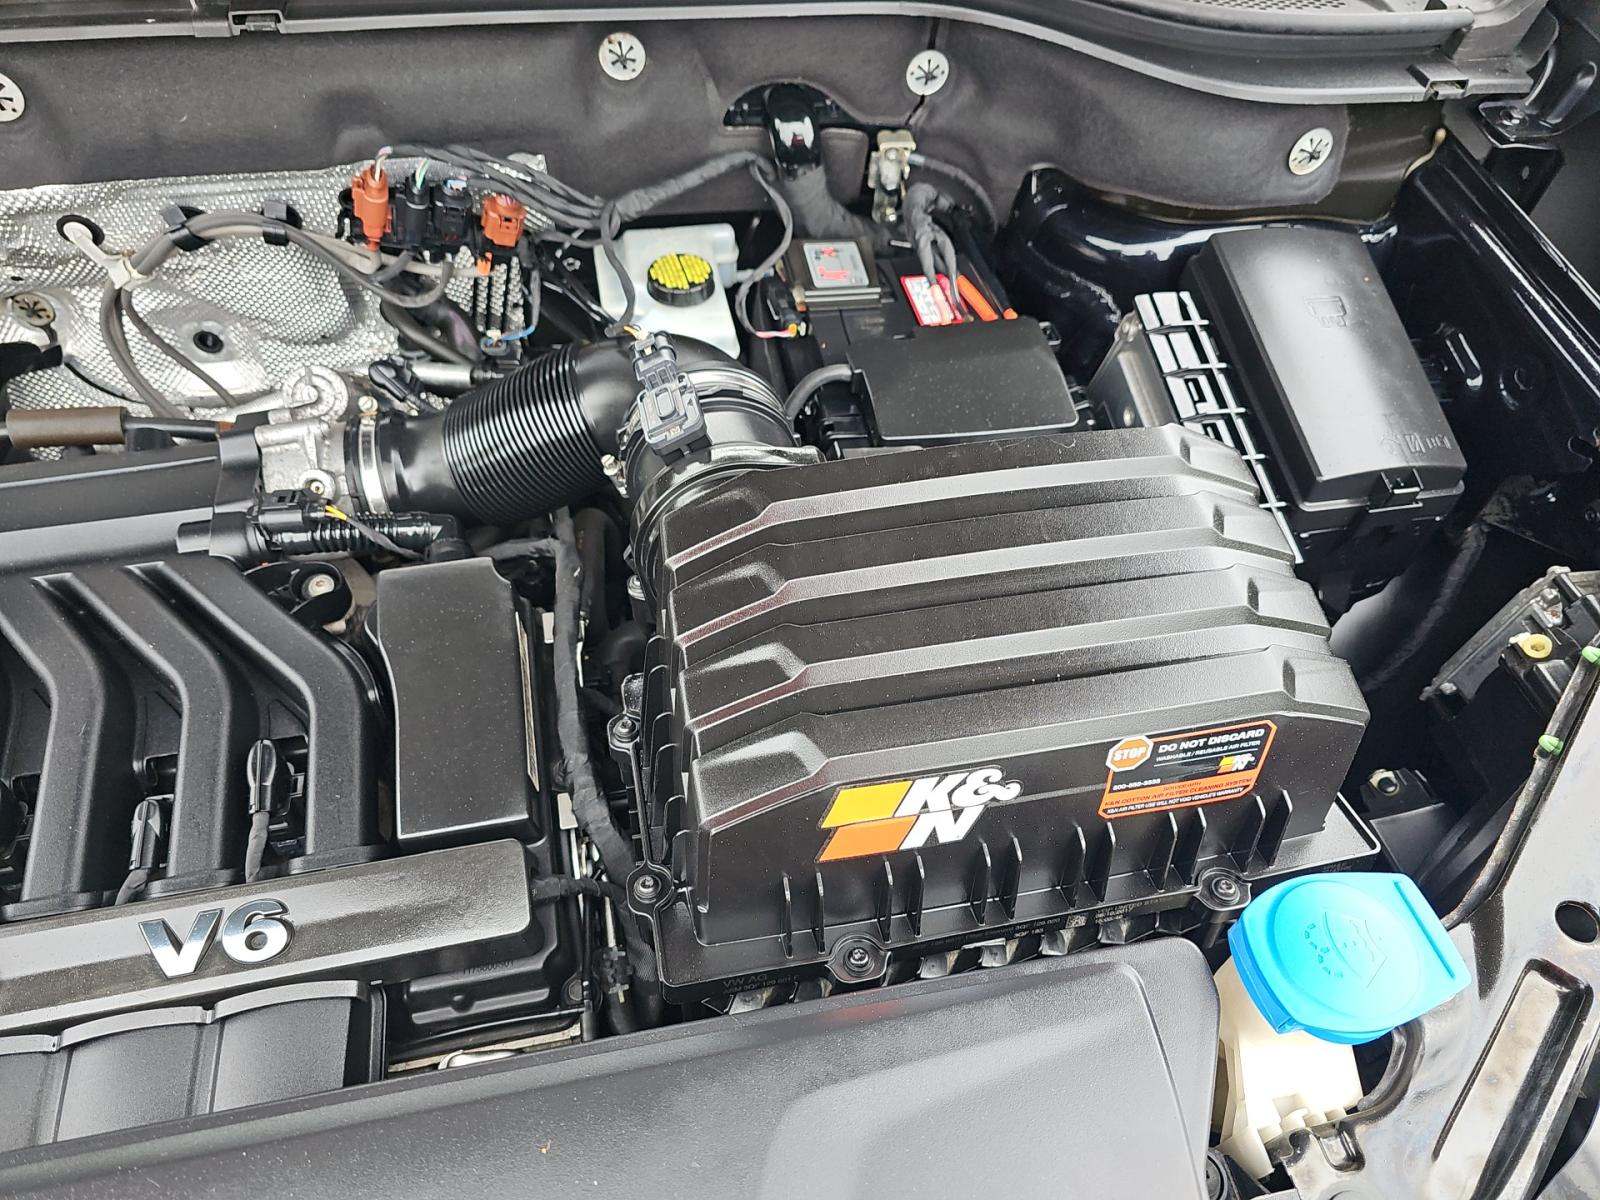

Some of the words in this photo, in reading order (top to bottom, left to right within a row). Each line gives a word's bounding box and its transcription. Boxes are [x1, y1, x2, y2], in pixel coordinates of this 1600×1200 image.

[1158, 742, 1177, 753] DO
[1179, 737, 1207, 750] NOT
[1208, 728, 1265, 745] DISCARD
[1228, 743, 1239, 751] AIR
[1240, 740, 1261, 748] FILTER
[1113, 746, 1147, 761] STOP
[1151, 792, 1164, 800] AIR
[1164, 789, 1189, 798] FILTER
[138, 898, 295, 978] V6
[723, 976, 745, 988] VW
